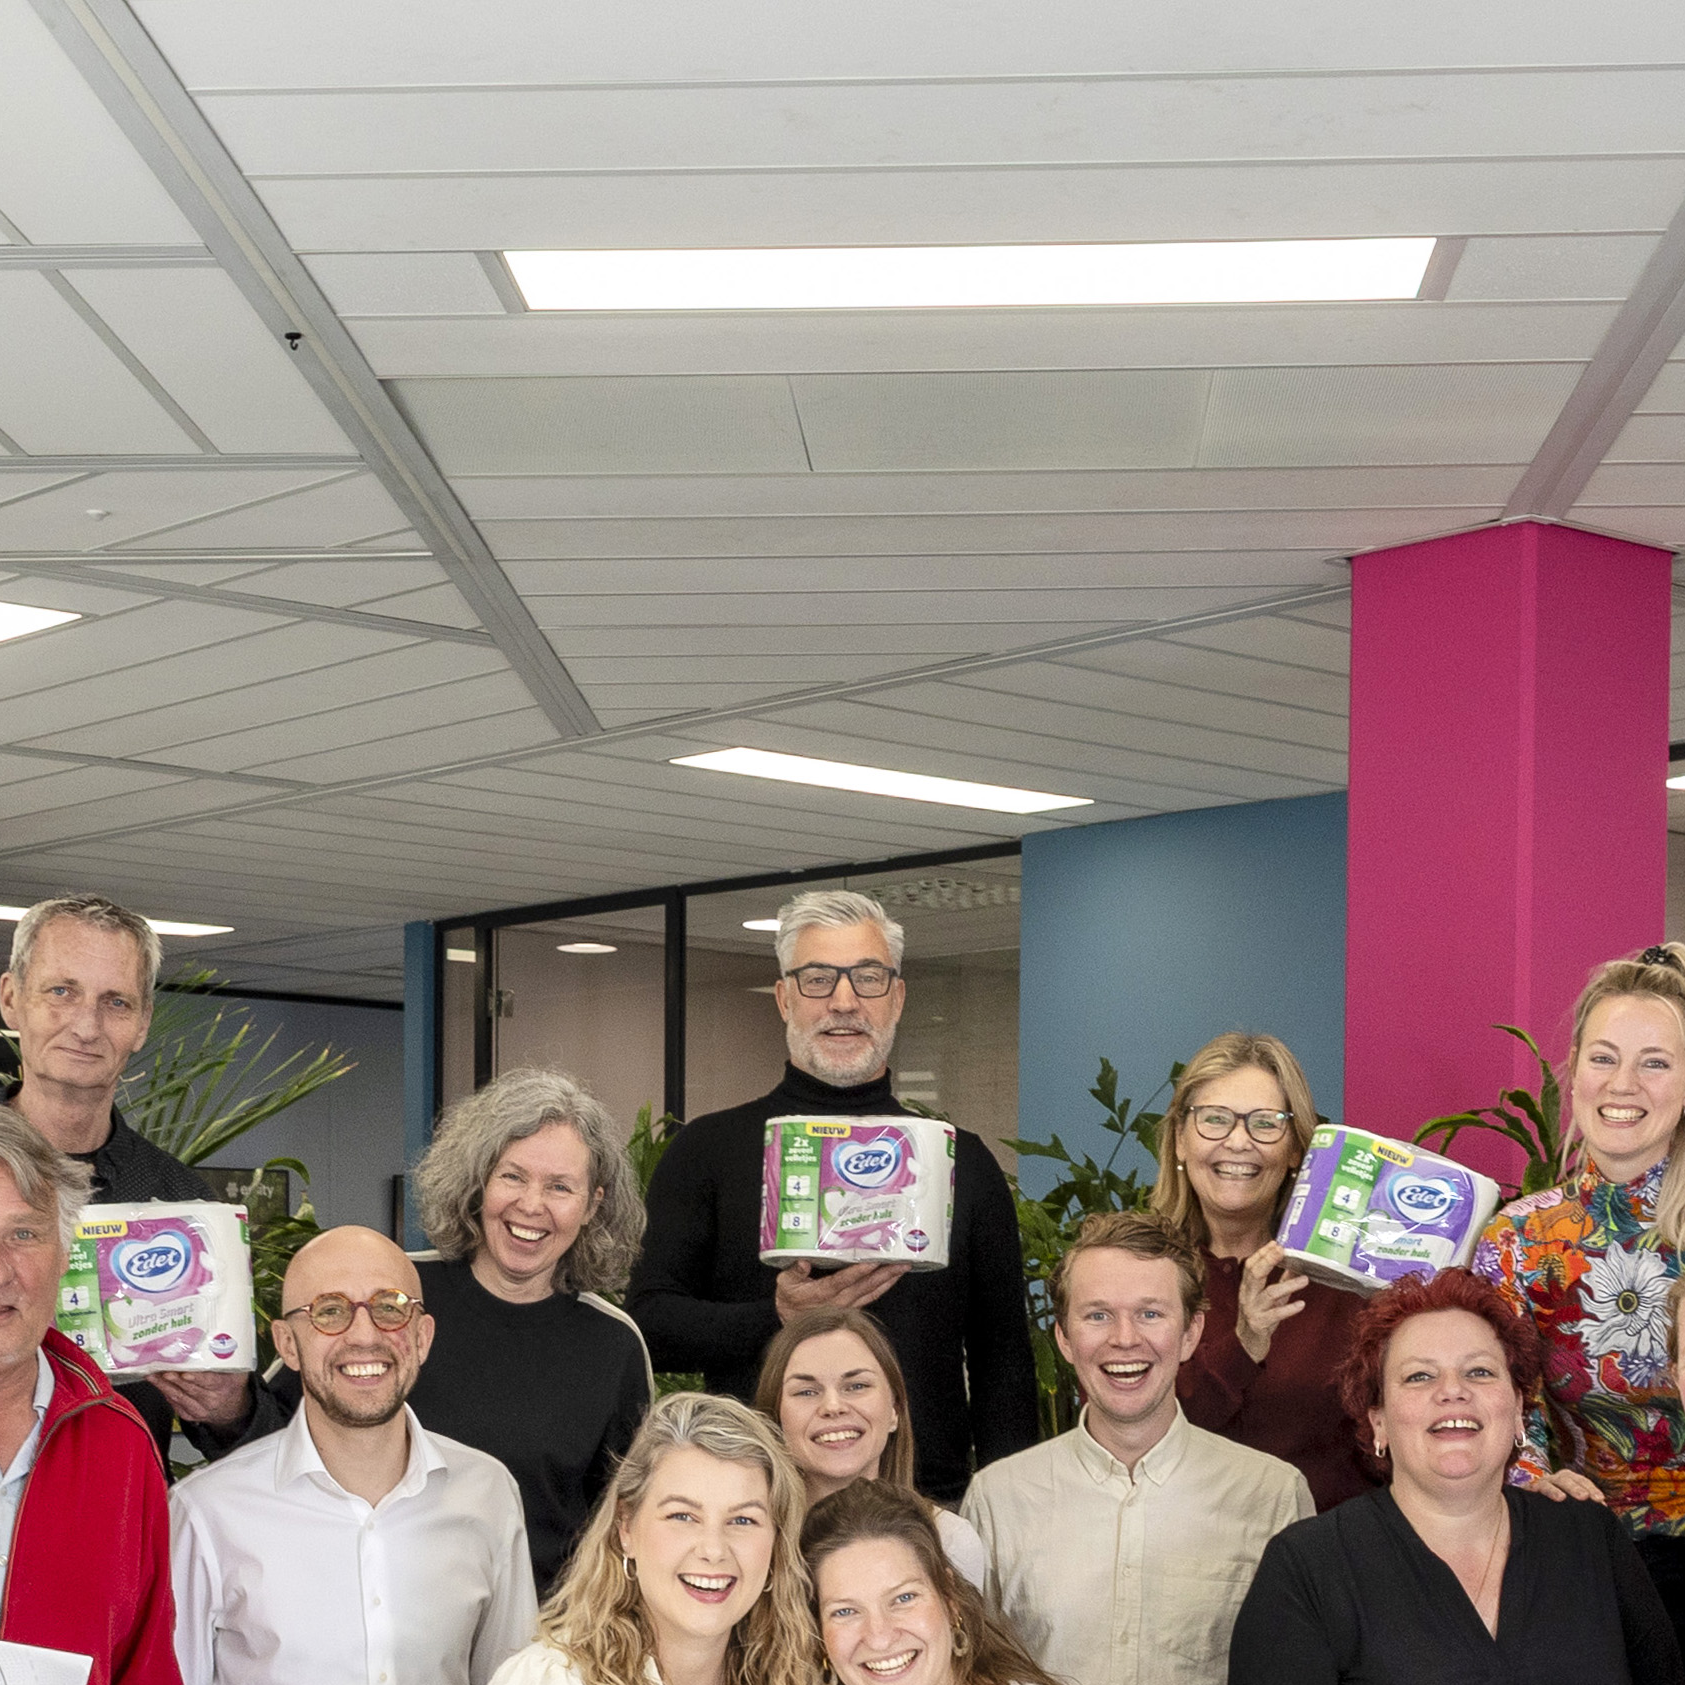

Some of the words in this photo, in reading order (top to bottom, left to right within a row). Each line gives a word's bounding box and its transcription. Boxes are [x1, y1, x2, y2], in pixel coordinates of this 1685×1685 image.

[811, 1126, 847, 1135] NIEUW
[793, 1137, 809, 1147] 2x
[1377, 1146, 1410, 1164] NIEUW
[847, 1154, 889, 1173] Edet
[793, 1182, 801, 1192] 4
[1342, 1194, 1351, 1204] 4
[792, 1217, 801, 1227] 8
[82, 1224, 122, 1235] NIEUW
[1331, 1226, 1341, 1238] 8
[1411, 1248, 1432, 1259] huls
[131, 1250, 178, 1275] Edet
[70, 1293, 79, 1306] 4
[128, 1313, 157, 1328] Ultra
[159, 1303, 195, 1319] Smart
[132, 1322, 169, 1341] zonder
[171, 1315, 193, 1329] huls
[76, 1334, 85, 1347] 8
